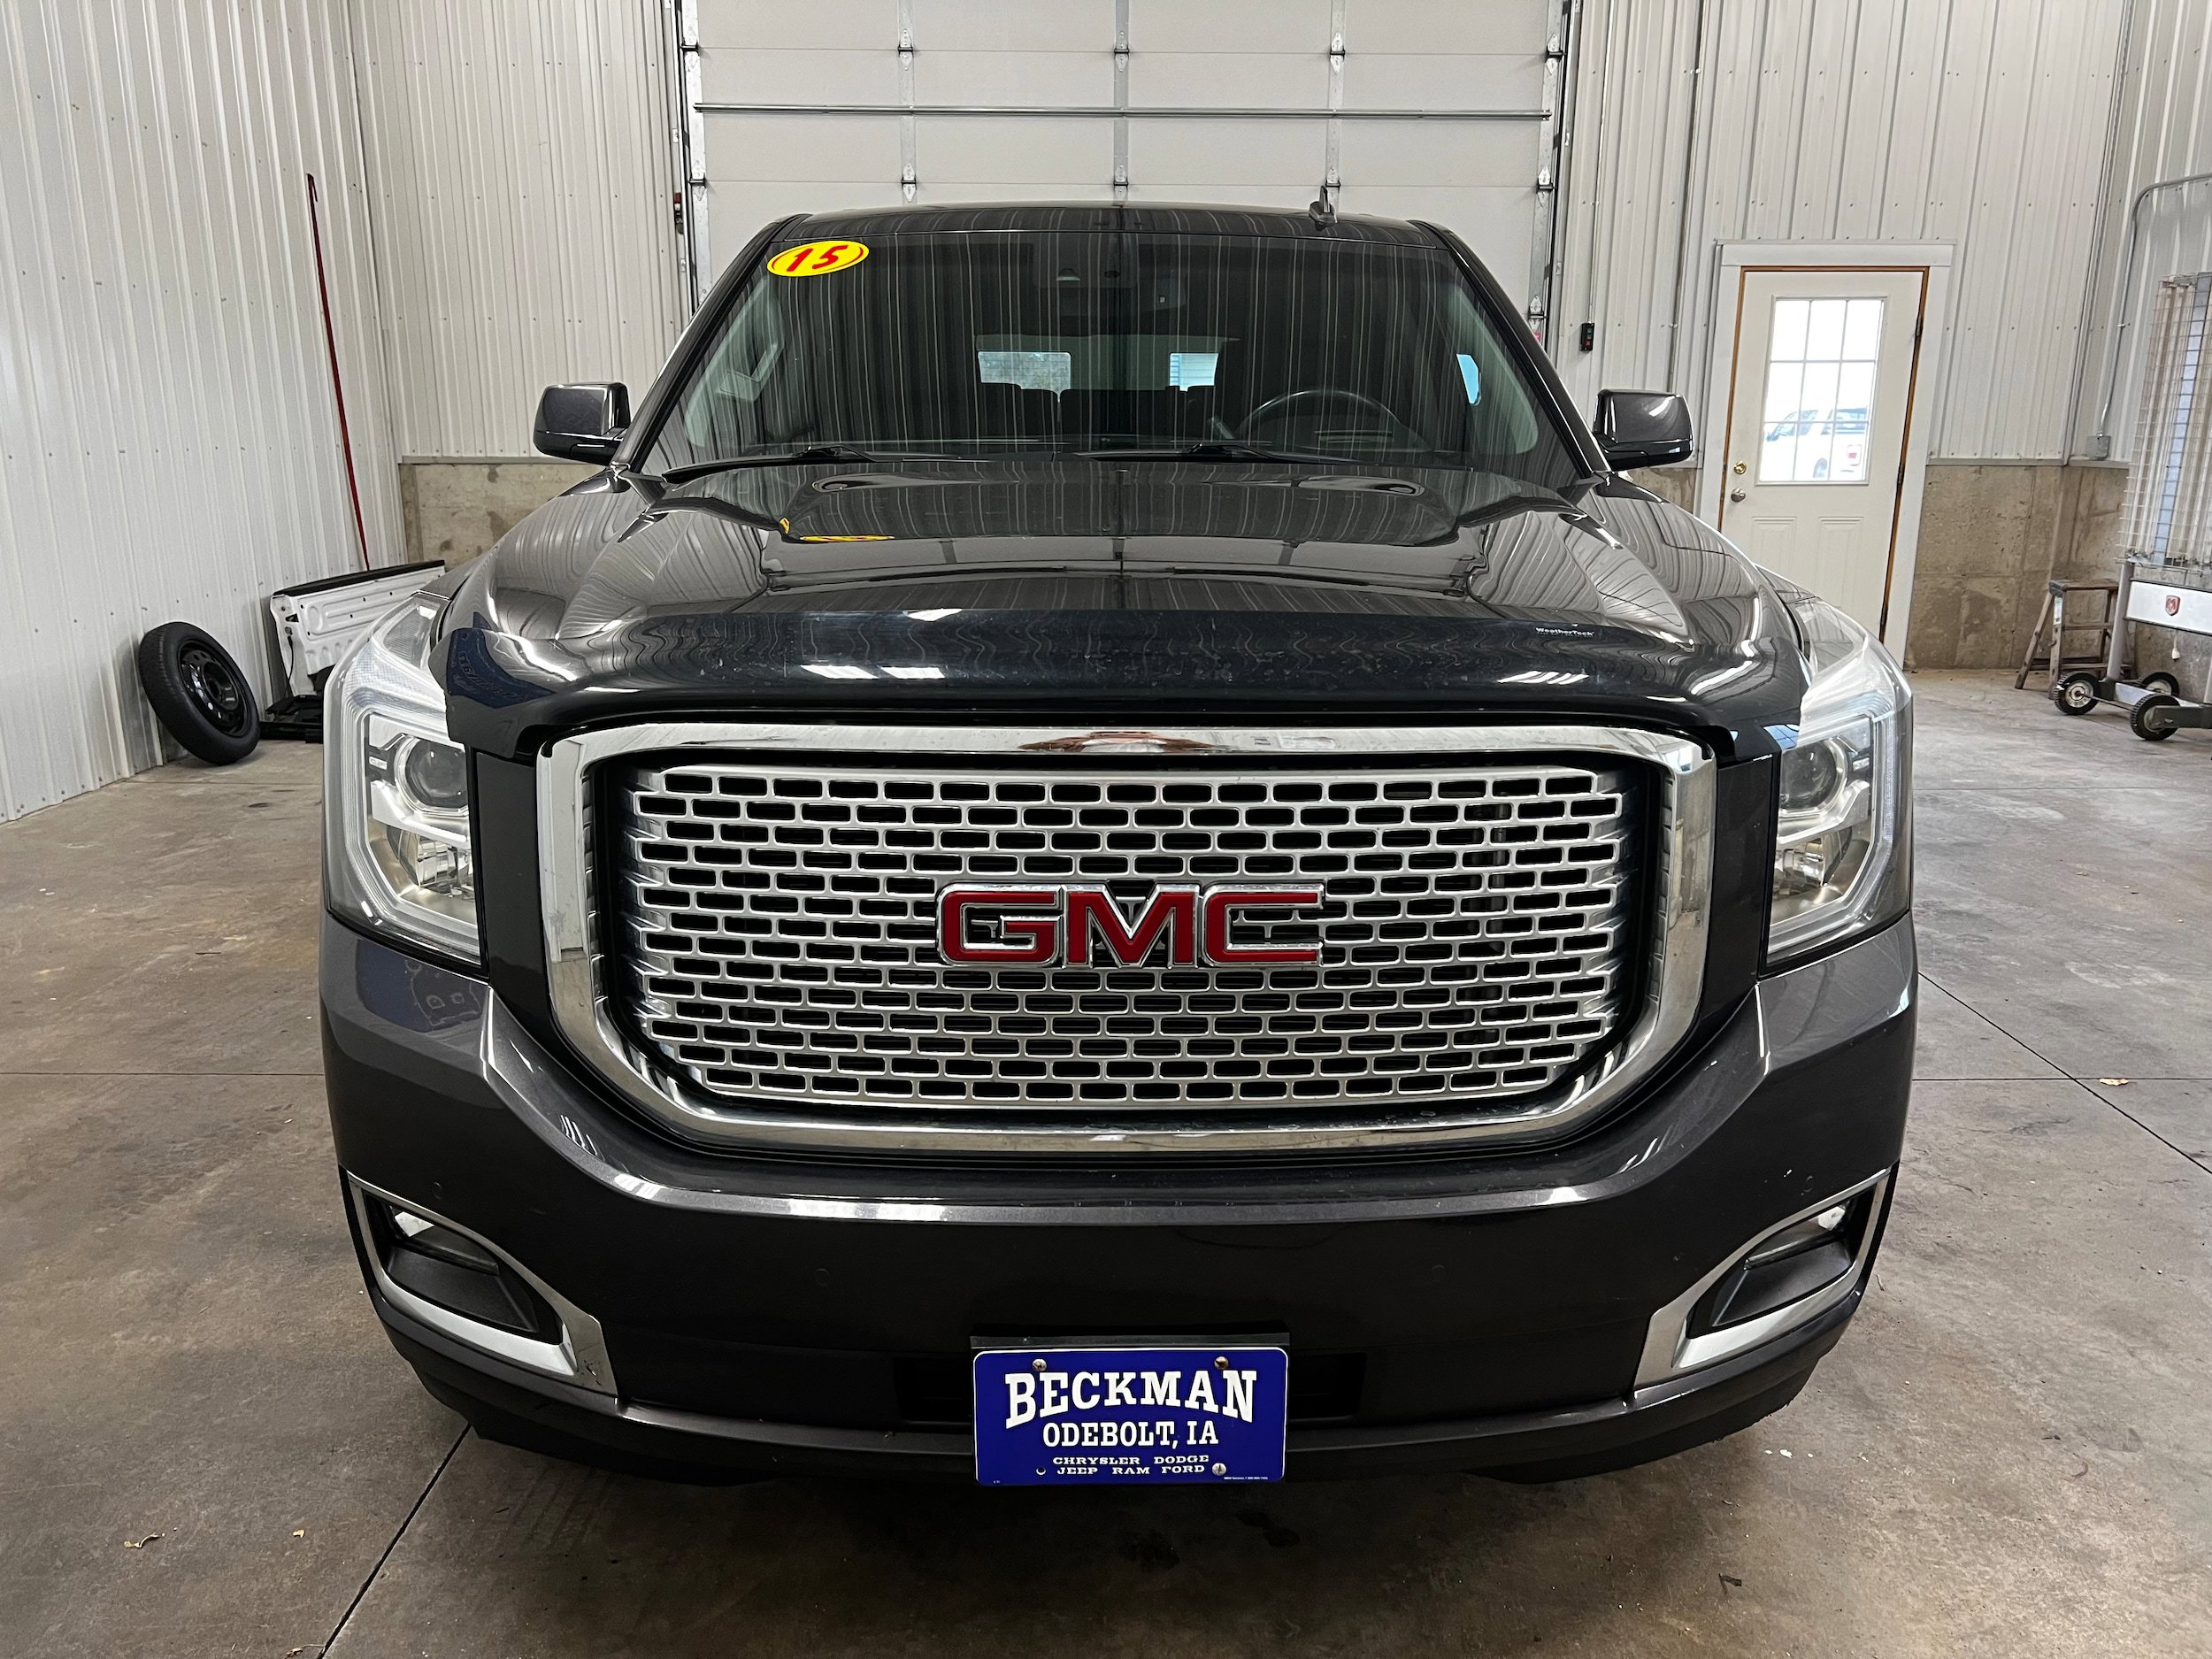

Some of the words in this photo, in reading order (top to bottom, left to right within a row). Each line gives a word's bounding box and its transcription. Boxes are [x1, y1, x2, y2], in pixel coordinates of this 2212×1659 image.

[786, 245, 849, 272] 15
[1535, 627, 1594, 636] WeatherTech
[937, 882, 1325, 969] GMC
[1004, 1370, 1257, 1429] BECKMAN
[1042, 1421, 1179, 1449] ODEBOLT,
[1187, 1420, 1219, 1446] IA
[1052, 1456, 1141, 1465] CHRYSLER
[1153, 1455, 1210, 1464] DODGE
[1056, 1466, 1098, 1475] JEEP
[1111, 1466, 1150, 1475] RAM
[1161, 1464, 1205, 1474] FORD
